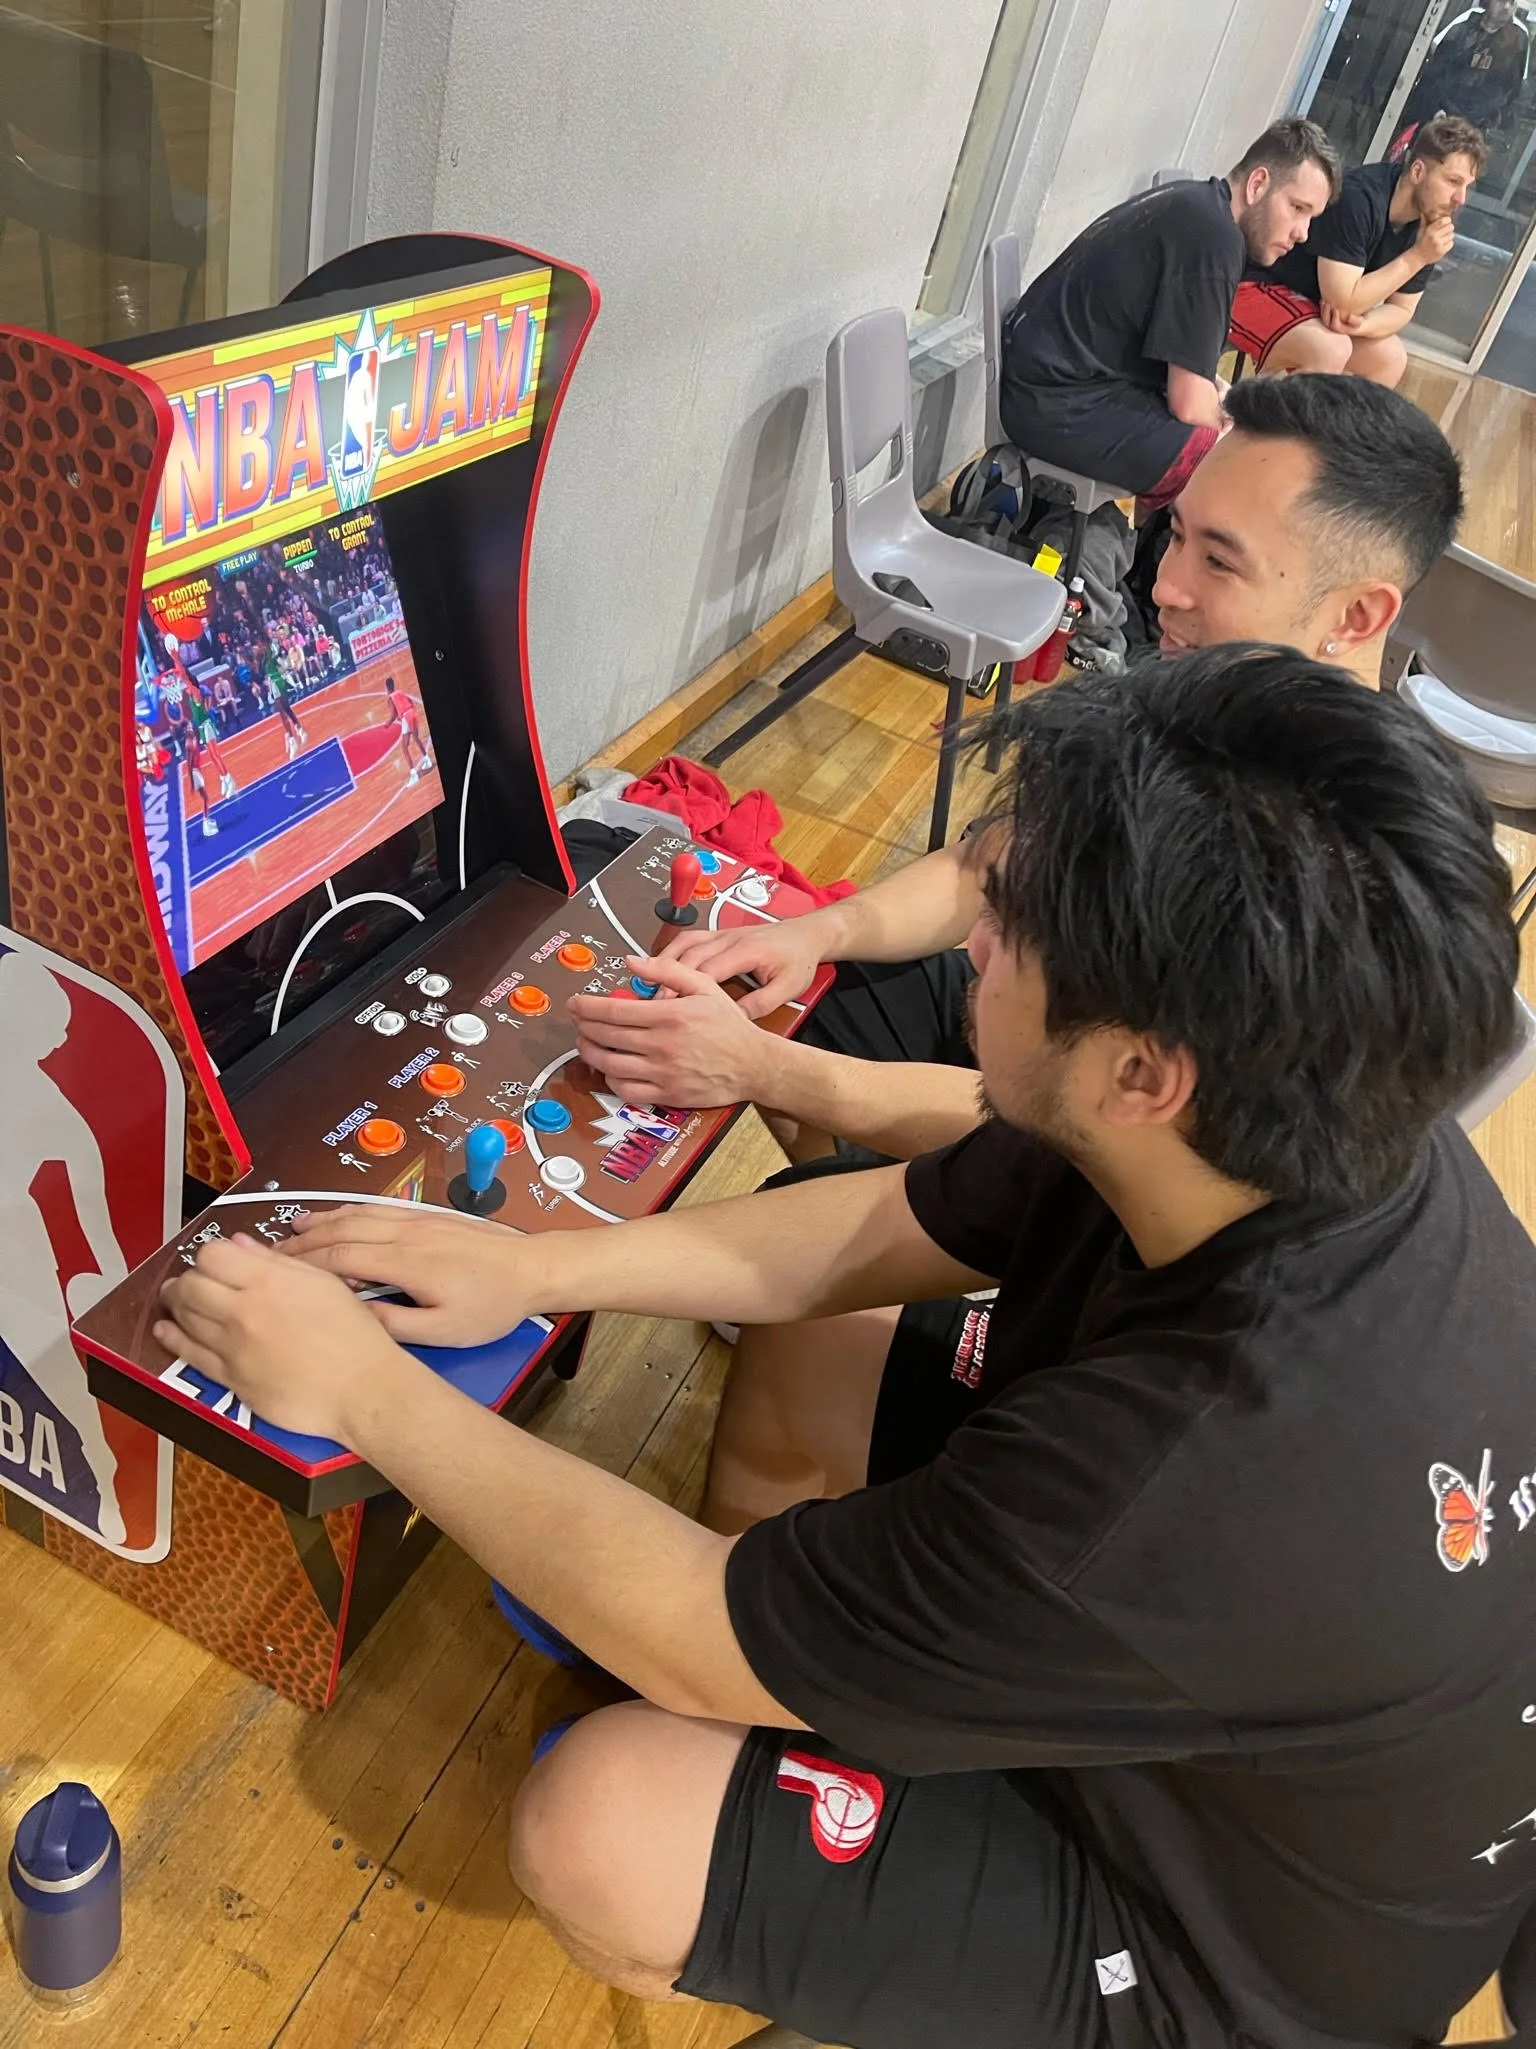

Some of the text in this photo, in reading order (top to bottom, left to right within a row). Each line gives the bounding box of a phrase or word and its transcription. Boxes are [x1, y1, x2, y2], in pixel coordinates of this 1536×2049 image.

[161, 305, 532, 543] NBA JAM
[328, 514, 375, 541] TO CONTROL
[341, 531, 367, 551] GRANT
[222, 551, 257, 573] FREE PLAY
[283, 538, 312, 559] PIPPEN
[293, 559, 314, 574] TURBO
[151, 579, 212, 612] TO CONTROL
[165, 596, 207, 622] McHALE
[144, 782, 173, 947] IDWAY
[529, 936, 561, 964] PLAYER
[479, 979, 514, 1008] PLAYER
[387, 1054, 428, 1089] PLAYER
[322, 1107, 367, 1147] PLAYER
[600, 1128, 668, 1184] NBA
[544, 1194, 563, 1213] TURBO
